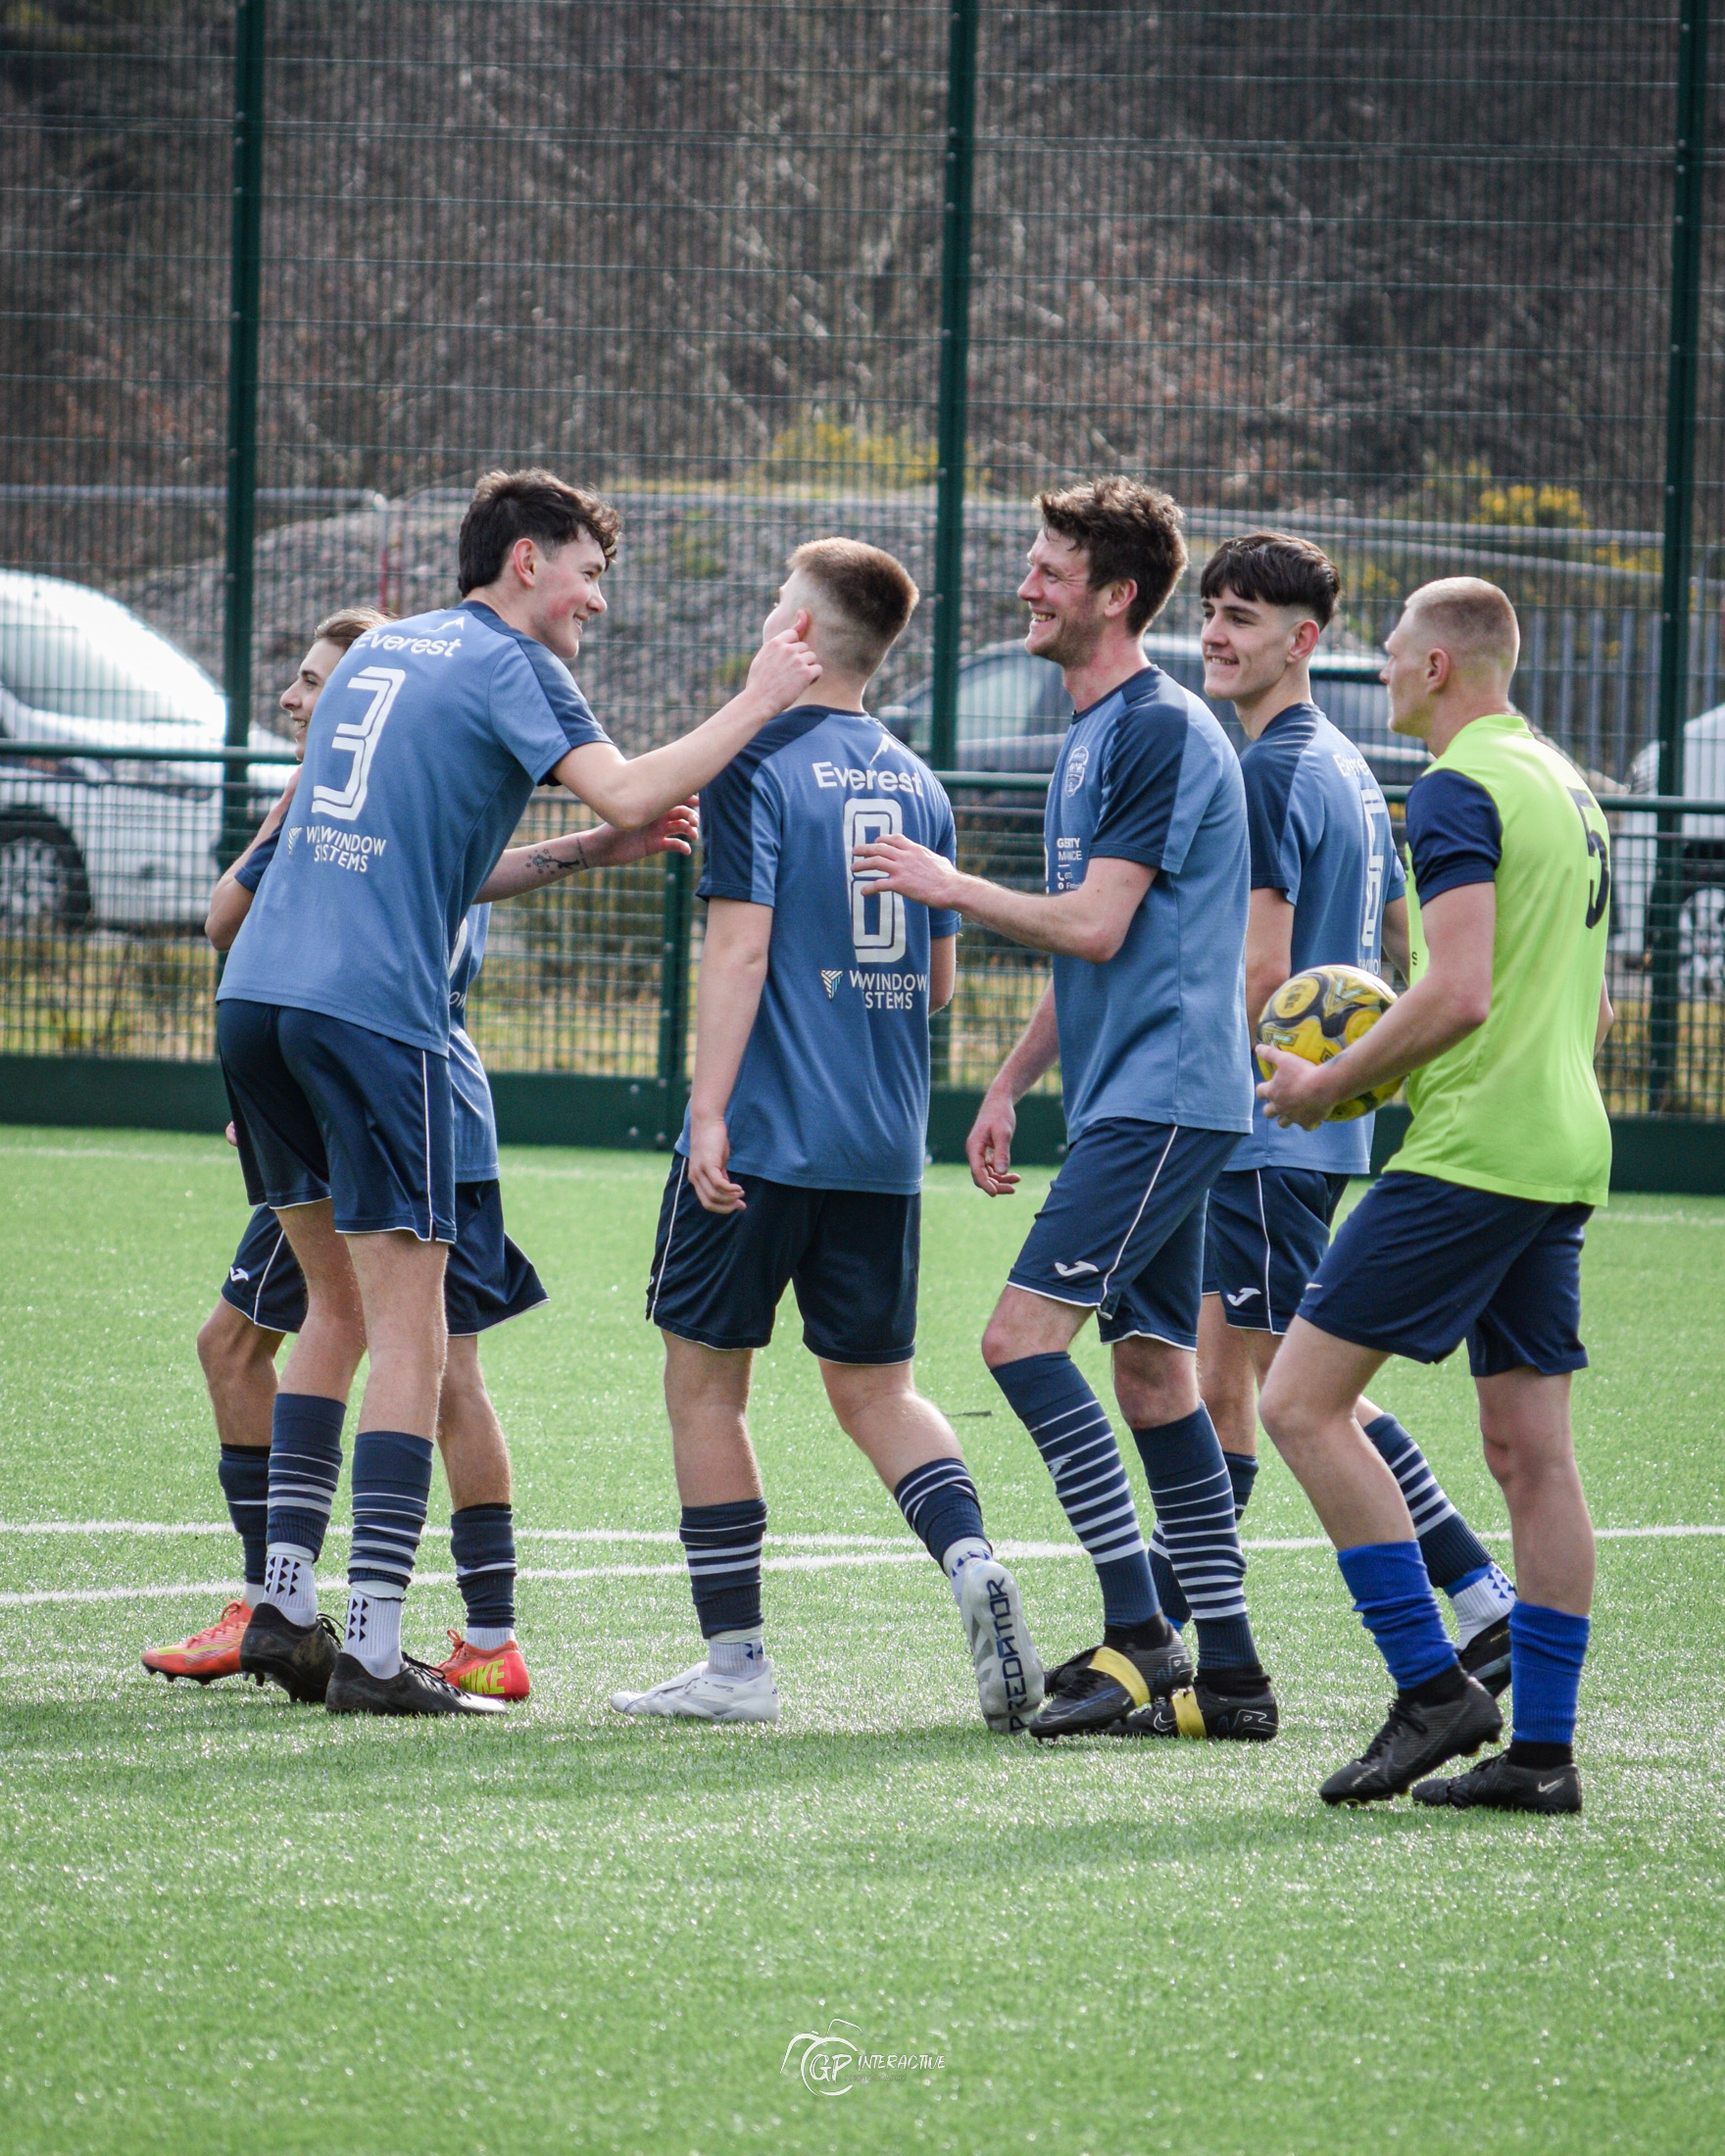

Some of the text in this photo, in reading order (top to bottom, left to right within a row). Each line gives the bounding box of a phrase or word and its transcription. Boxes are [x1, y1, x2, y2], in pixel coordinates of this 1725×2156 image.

[353, 630, 462, 658] Everest
[311, 665, 406, 821] 3
[812, 760, 924, 798] Everest
[314, 843, 369, 873] SSTEMS
[1566, 786, 1609, 930] 5
[863, 991, 913, 1010] STEMS
[986, 1576, 1029, 1733] PREDATOR
[459, 1659, 506, 1695] NIKE
